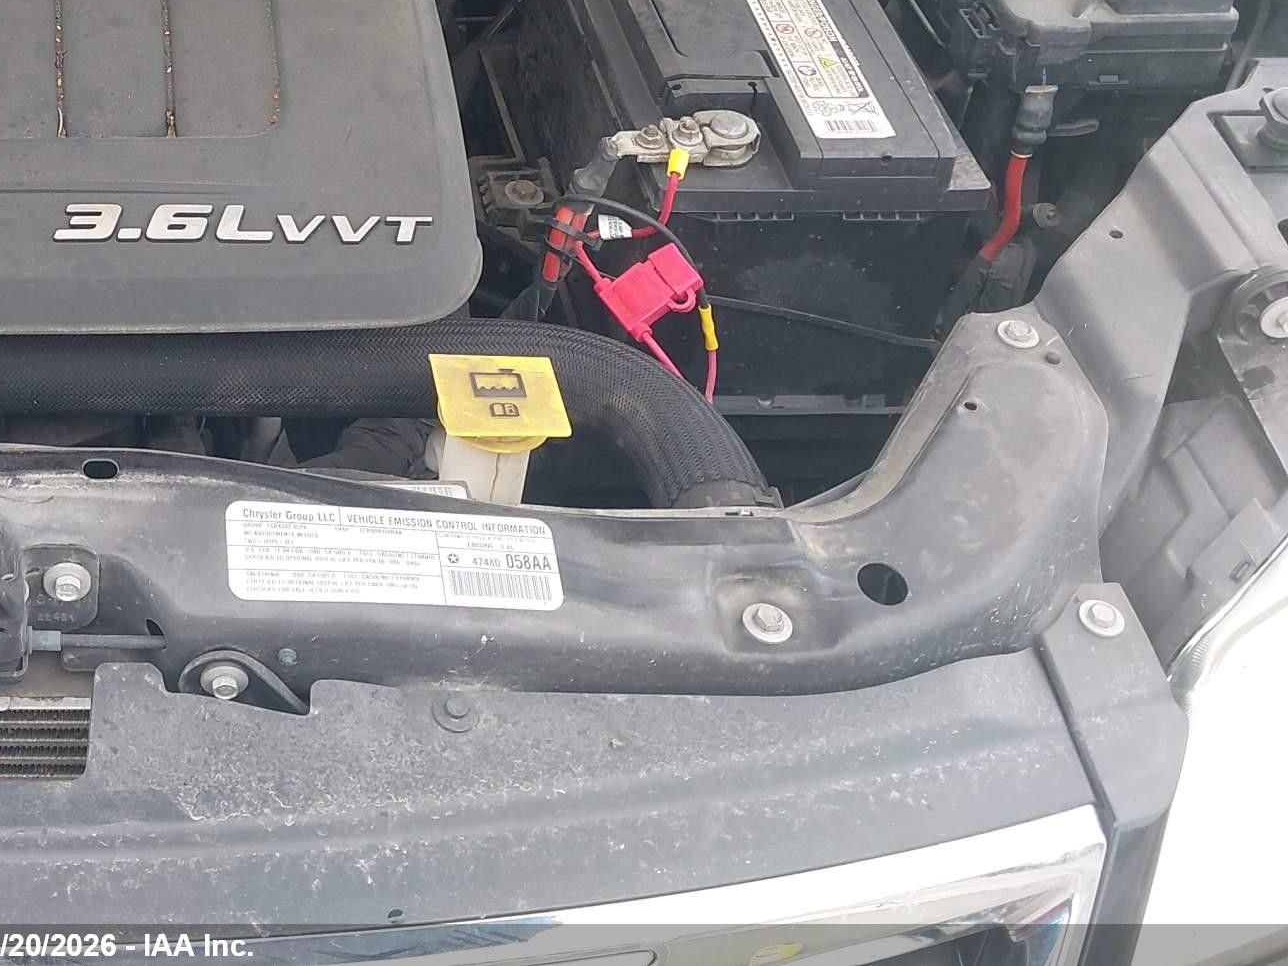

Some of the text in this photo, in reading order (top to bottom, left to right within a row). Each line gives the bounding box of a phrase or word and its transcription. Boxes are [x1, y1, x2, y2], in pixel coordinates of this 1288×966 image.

[242, 508, 336, 523] Chrysler Group LLC
[346, 513, 546, 535] VEHICLE EMISSION CONTROL INFORMATION
